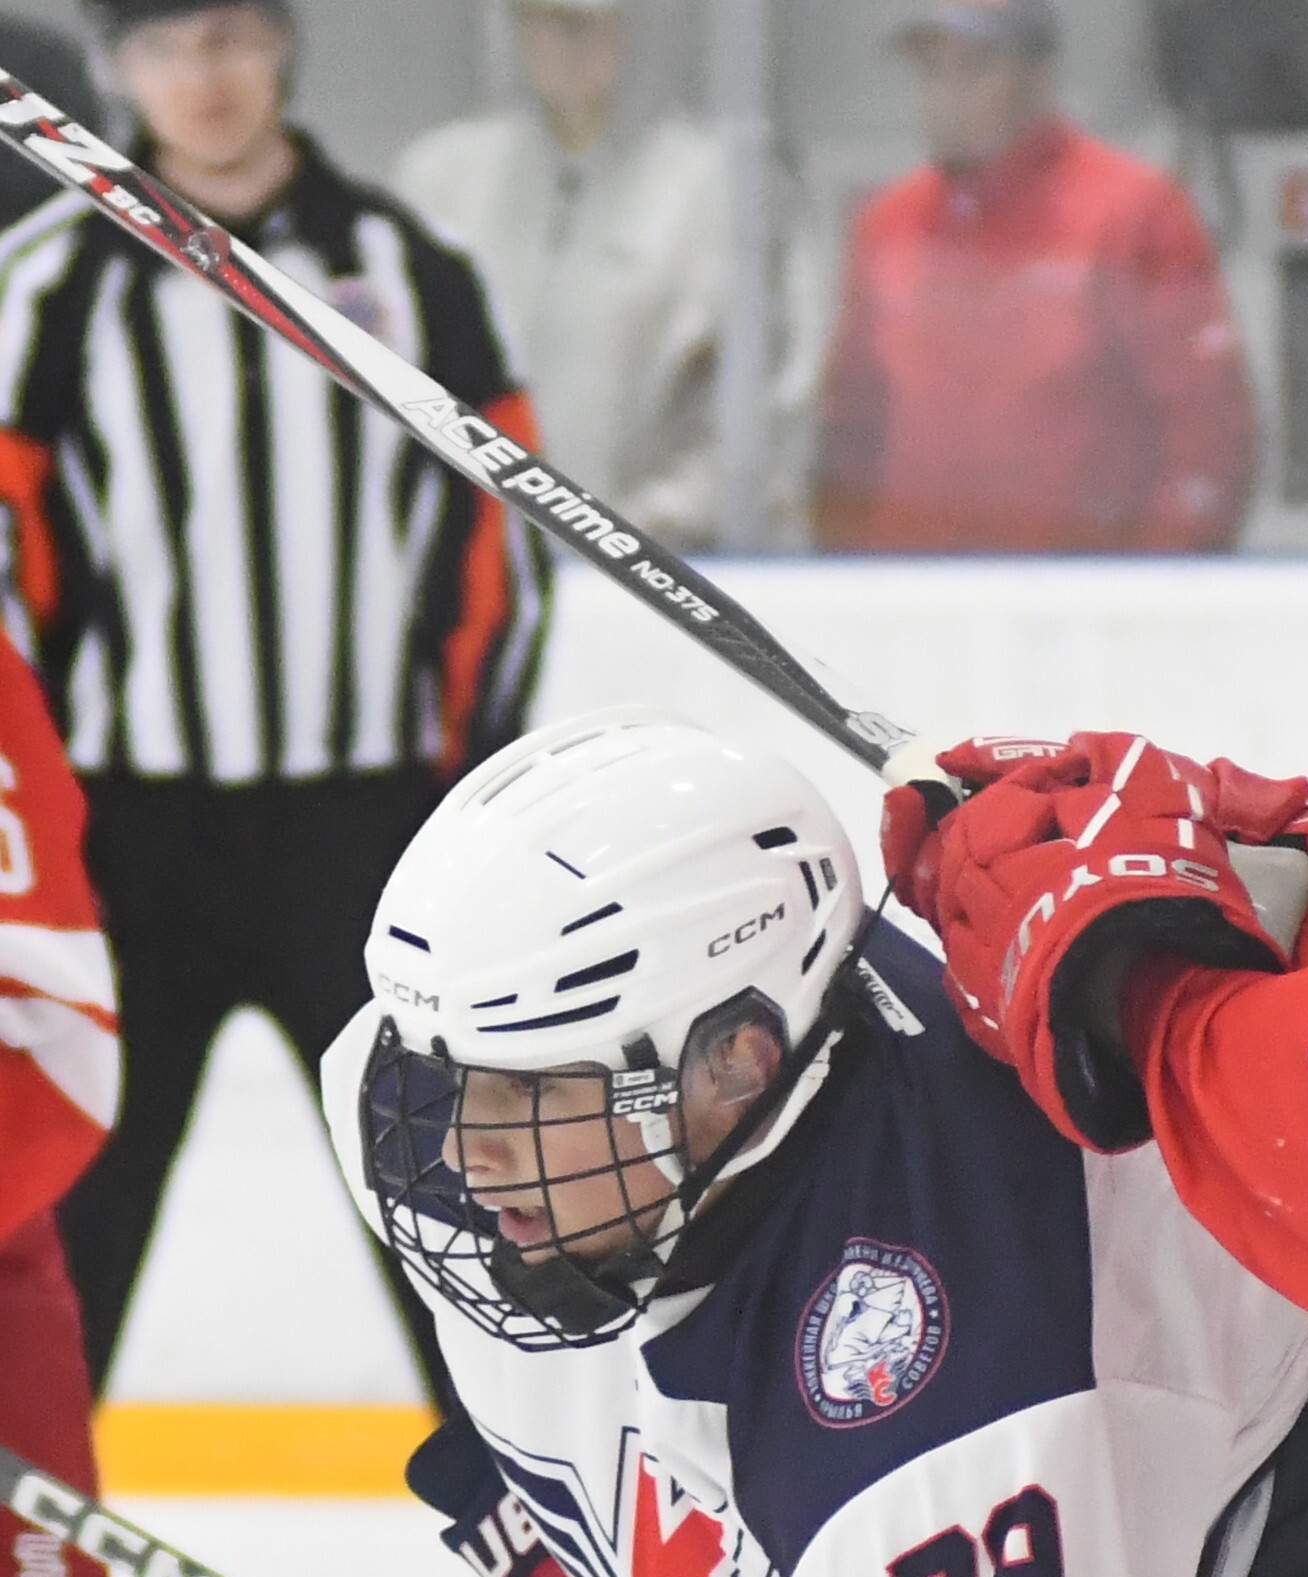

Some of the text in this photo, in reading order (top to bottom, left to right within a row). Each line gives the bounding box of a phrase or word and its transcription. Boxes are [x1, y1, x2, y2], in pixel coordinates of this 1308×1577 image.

[402, 396, 528, 472] ACE
[501, 467, 641, 559] prime
[707, 902, 785, 958] CCM
[379, 973, 440, 1012] CCM
[612, 1090, 679, 1114] CCM
